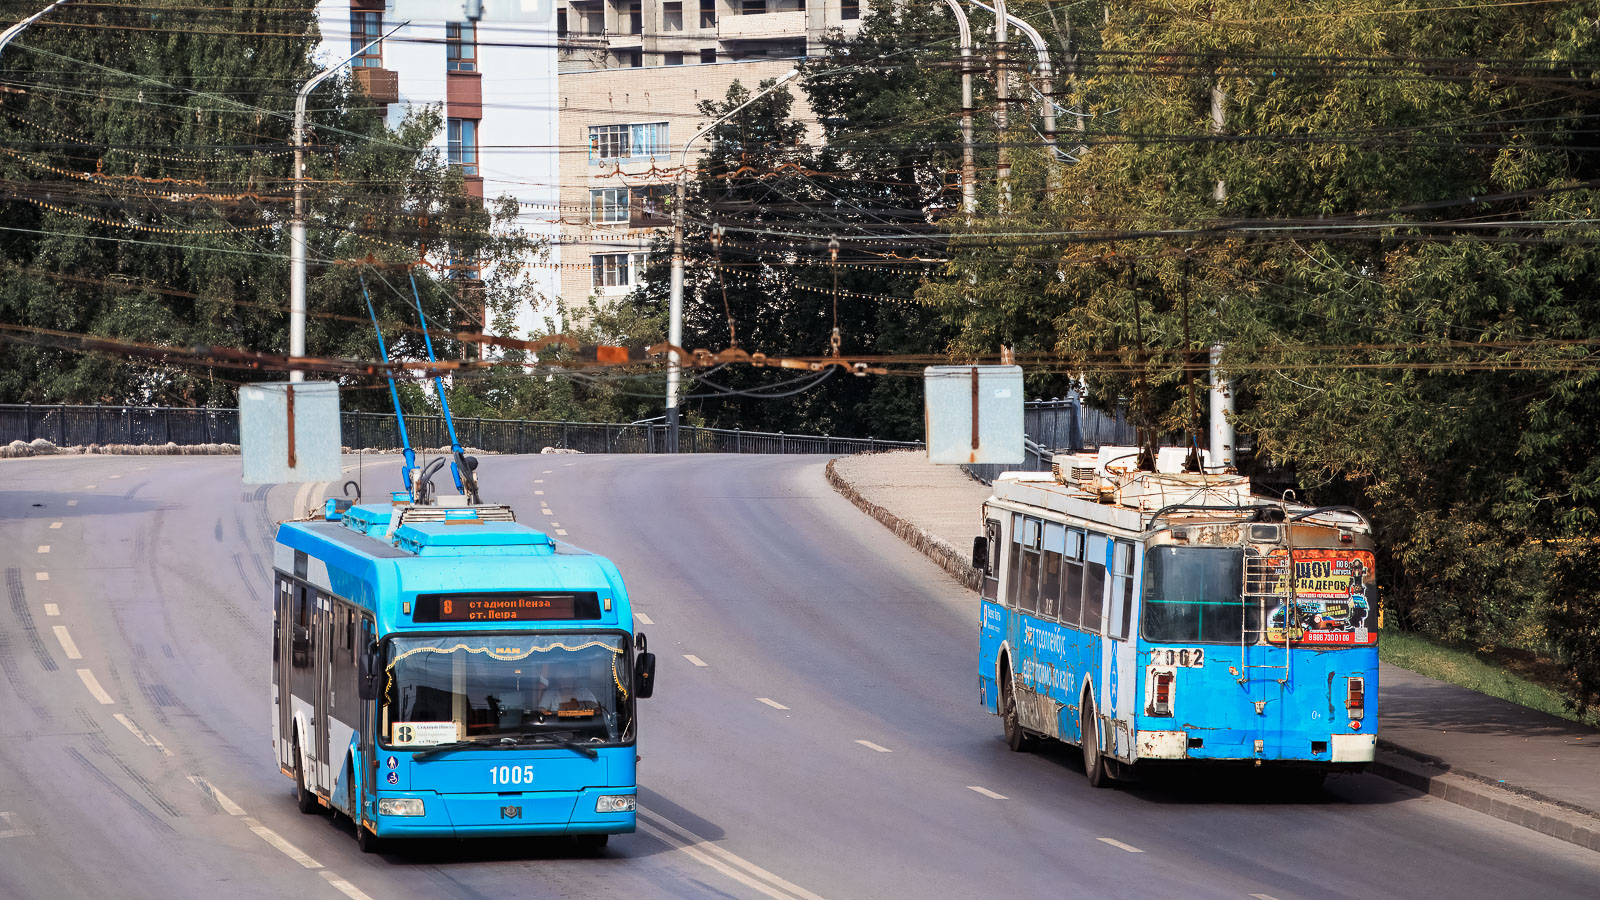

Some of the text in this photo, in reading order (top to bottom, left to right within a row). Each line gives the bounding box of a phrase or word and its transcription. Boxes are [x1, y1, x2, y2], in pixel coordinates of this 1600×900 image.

[1295, 561, 1331, 579] ШОУ
[444, 599, 550, 614] 8 стадион Пенза
[398, 726, 412, 742] 8
[490, 766, 534, 784] 1005
